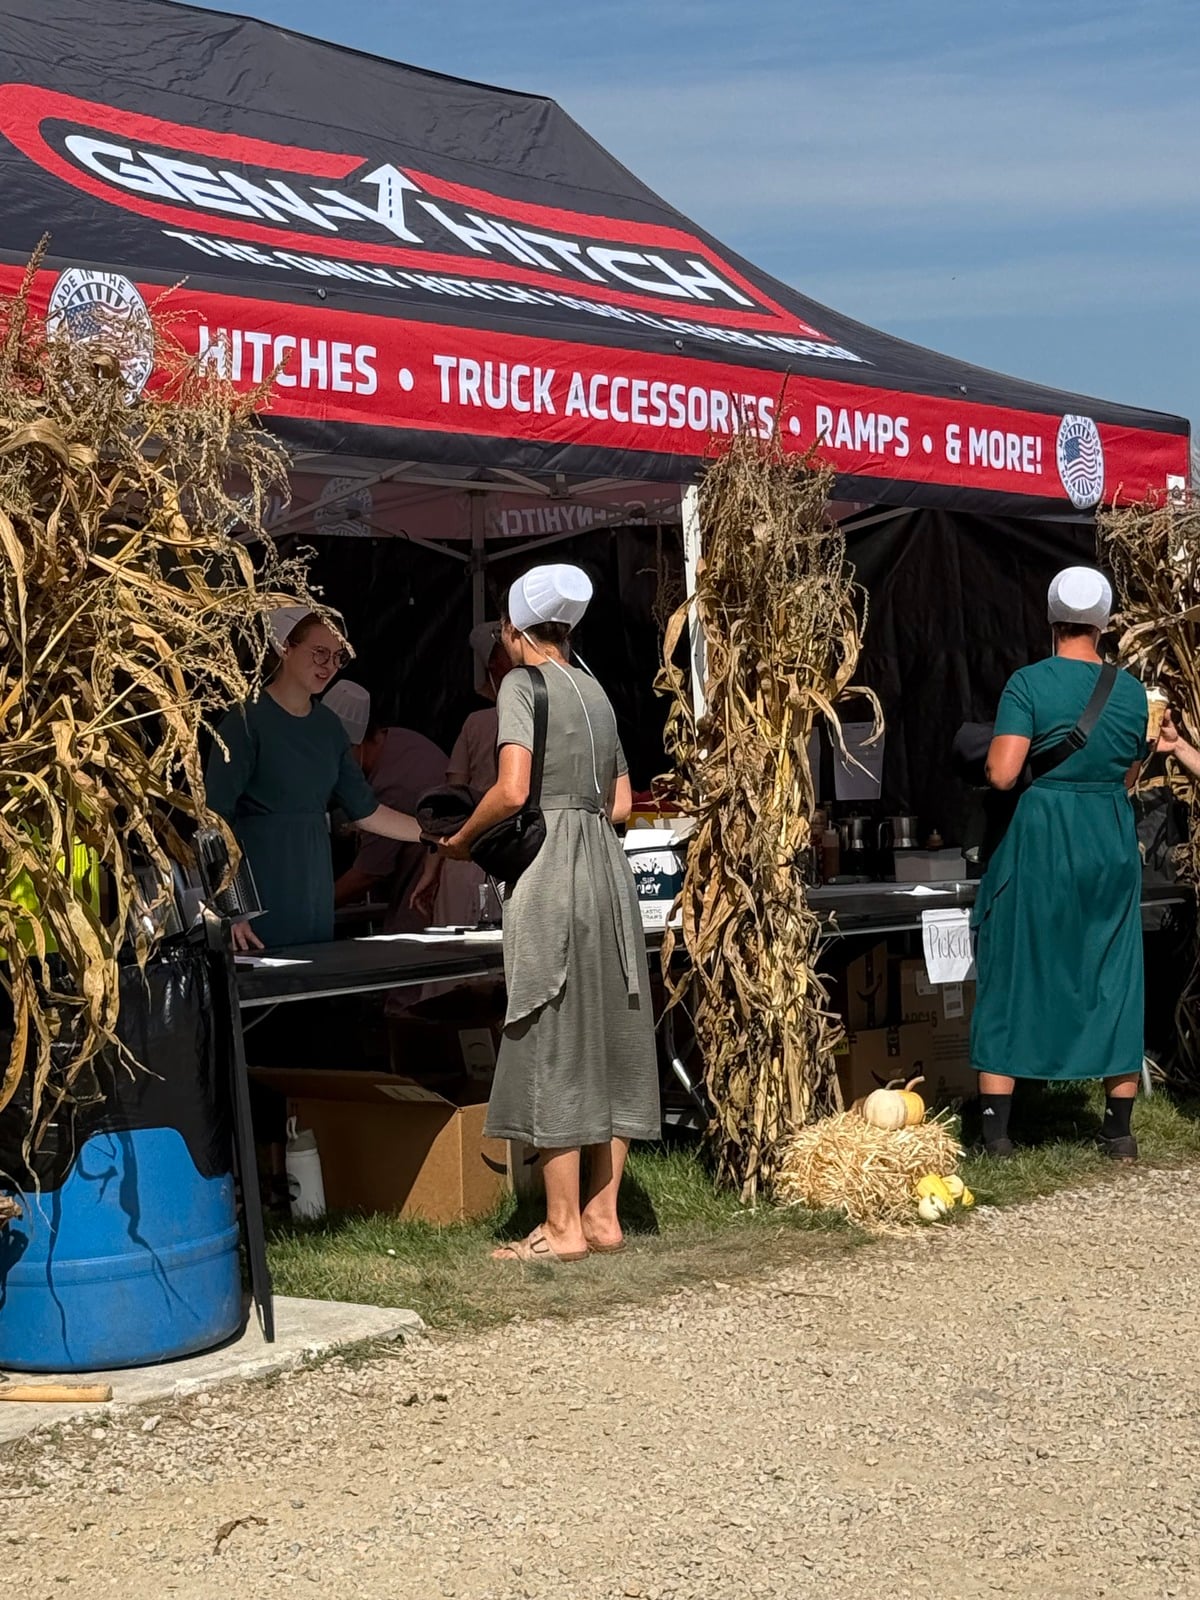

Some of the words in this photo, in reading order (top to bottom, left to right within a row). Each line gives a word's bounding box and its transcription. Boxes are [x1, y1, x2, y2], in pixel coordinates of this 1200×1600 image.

[161, 230, 292, 269] THE
[272, 251, 411, 288] ONLY
[396, 271, 554, 306] HITCH
[416, 198, 755, 307] HITCH
[199, 325, 378, 396] HITCHES
[433, 354, 556, 415] TRUCK
[564, 370, 774, 440] ACCESSORIES
[816, 405, 910, 458] RAMPS
[945, 424, 961, 465] &
[968, 426, 1042, 475] MORE!
